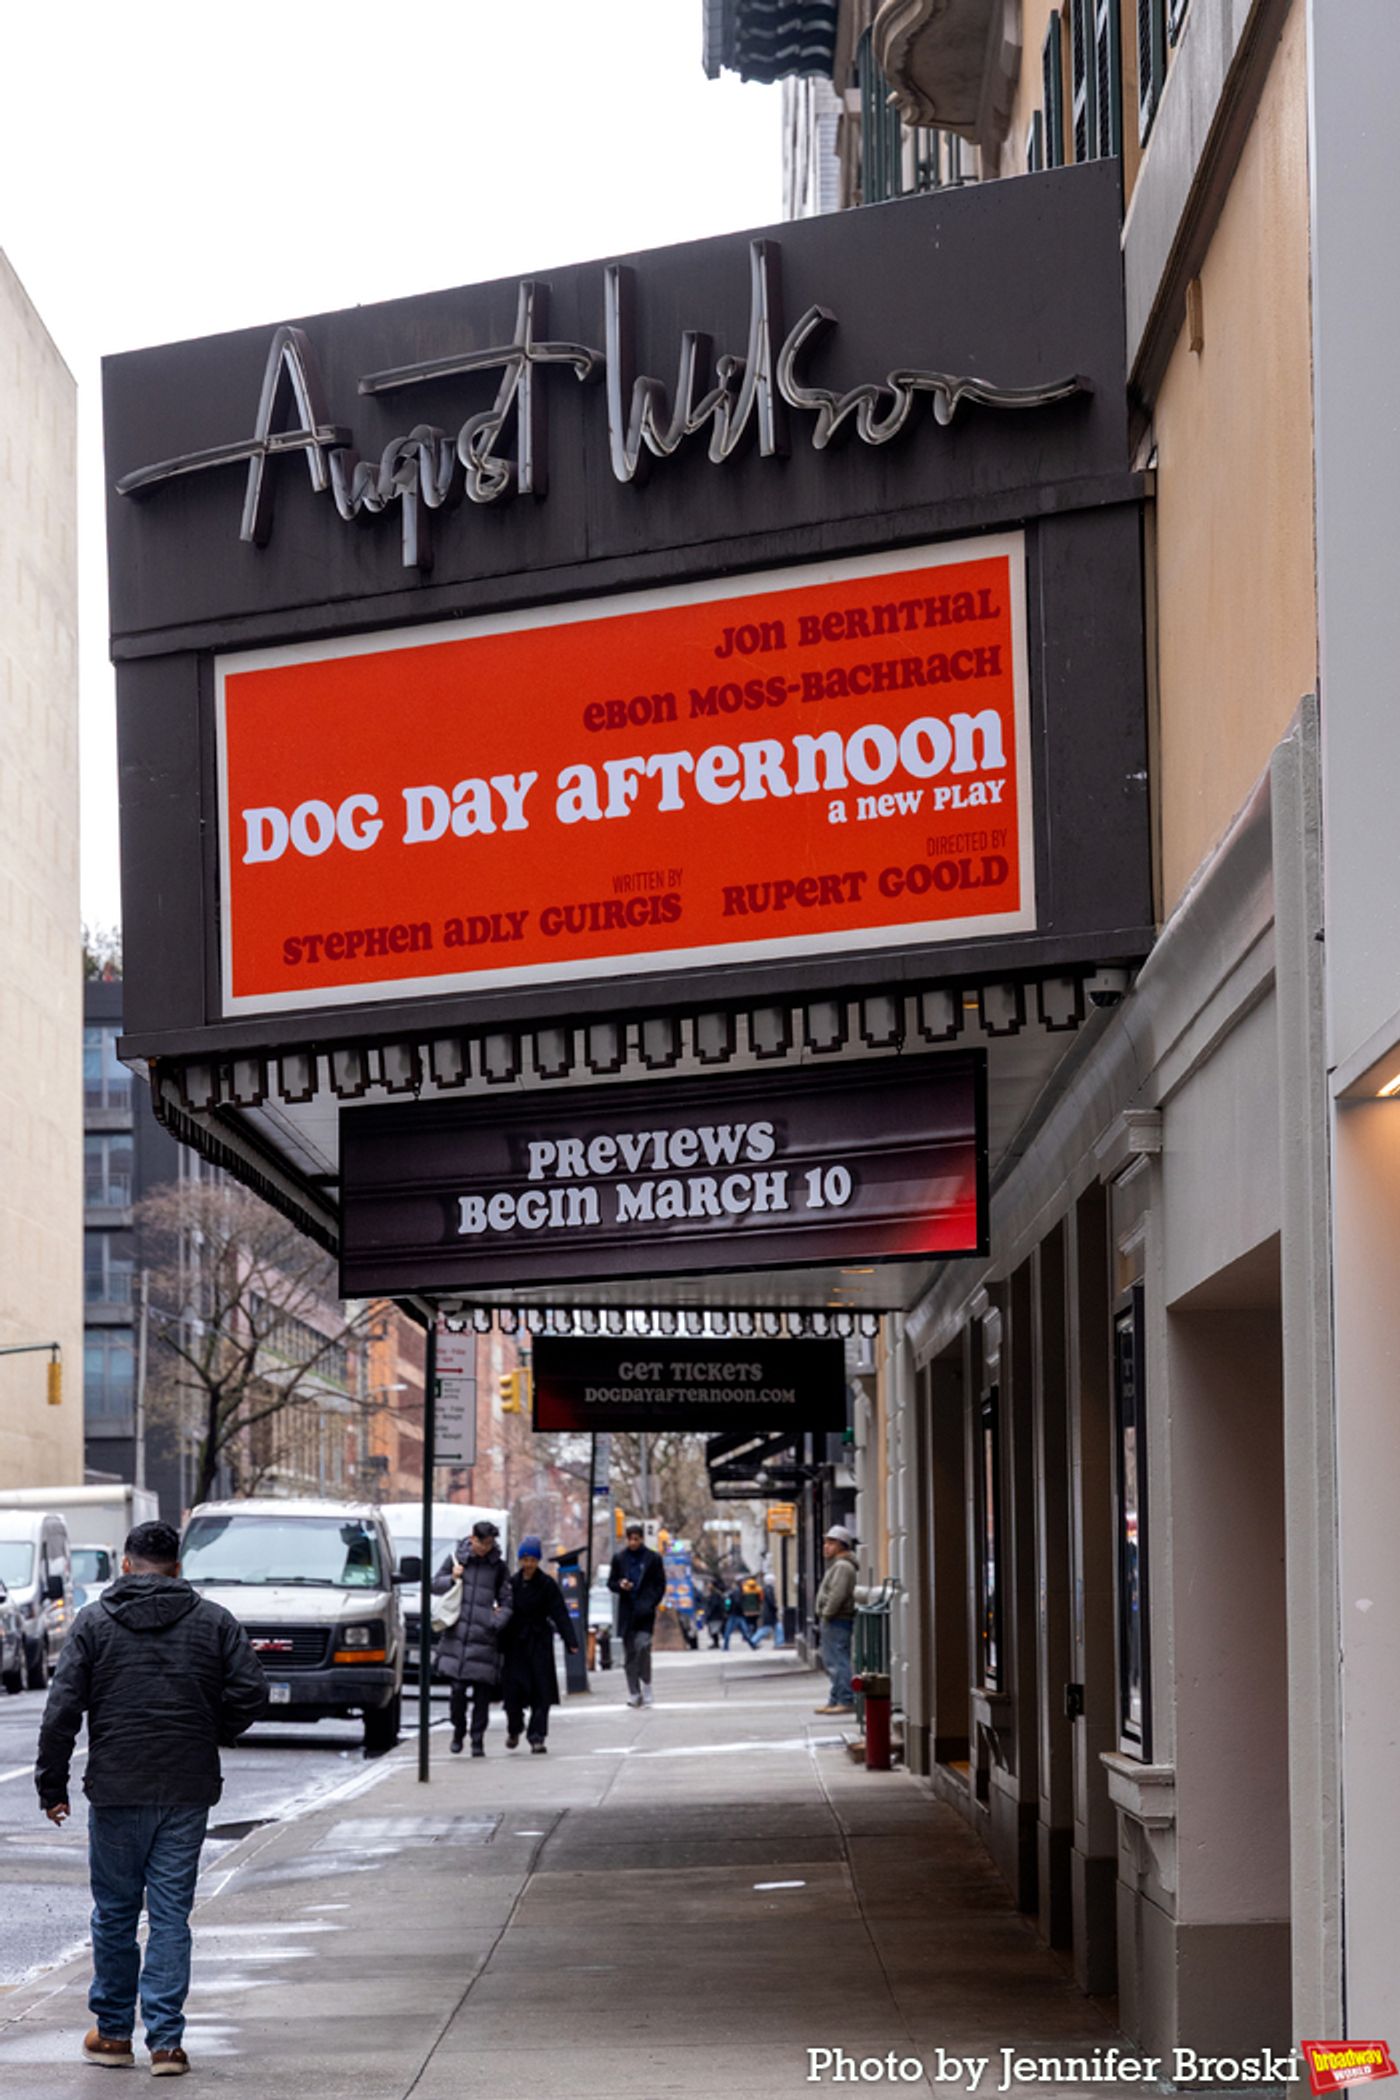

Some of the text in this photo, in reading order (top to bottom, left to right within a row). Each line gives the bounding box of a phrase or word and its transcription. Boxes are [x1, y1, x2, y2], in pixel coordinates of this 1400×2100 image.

[116, 238, 1093, 568] August Wilson
[242, 794, 384, 864] DOG
[827, 799, 848, 824] a
[926, 829, 1008, 858] DIRECTED BY
[612, 867, 683, 894] WRITTEN BY
[878, 855, 1009, 897] GOOLD
[539, 892, 683, 937] GUIRGIS
[805, 1165, 852, 1208] 10
